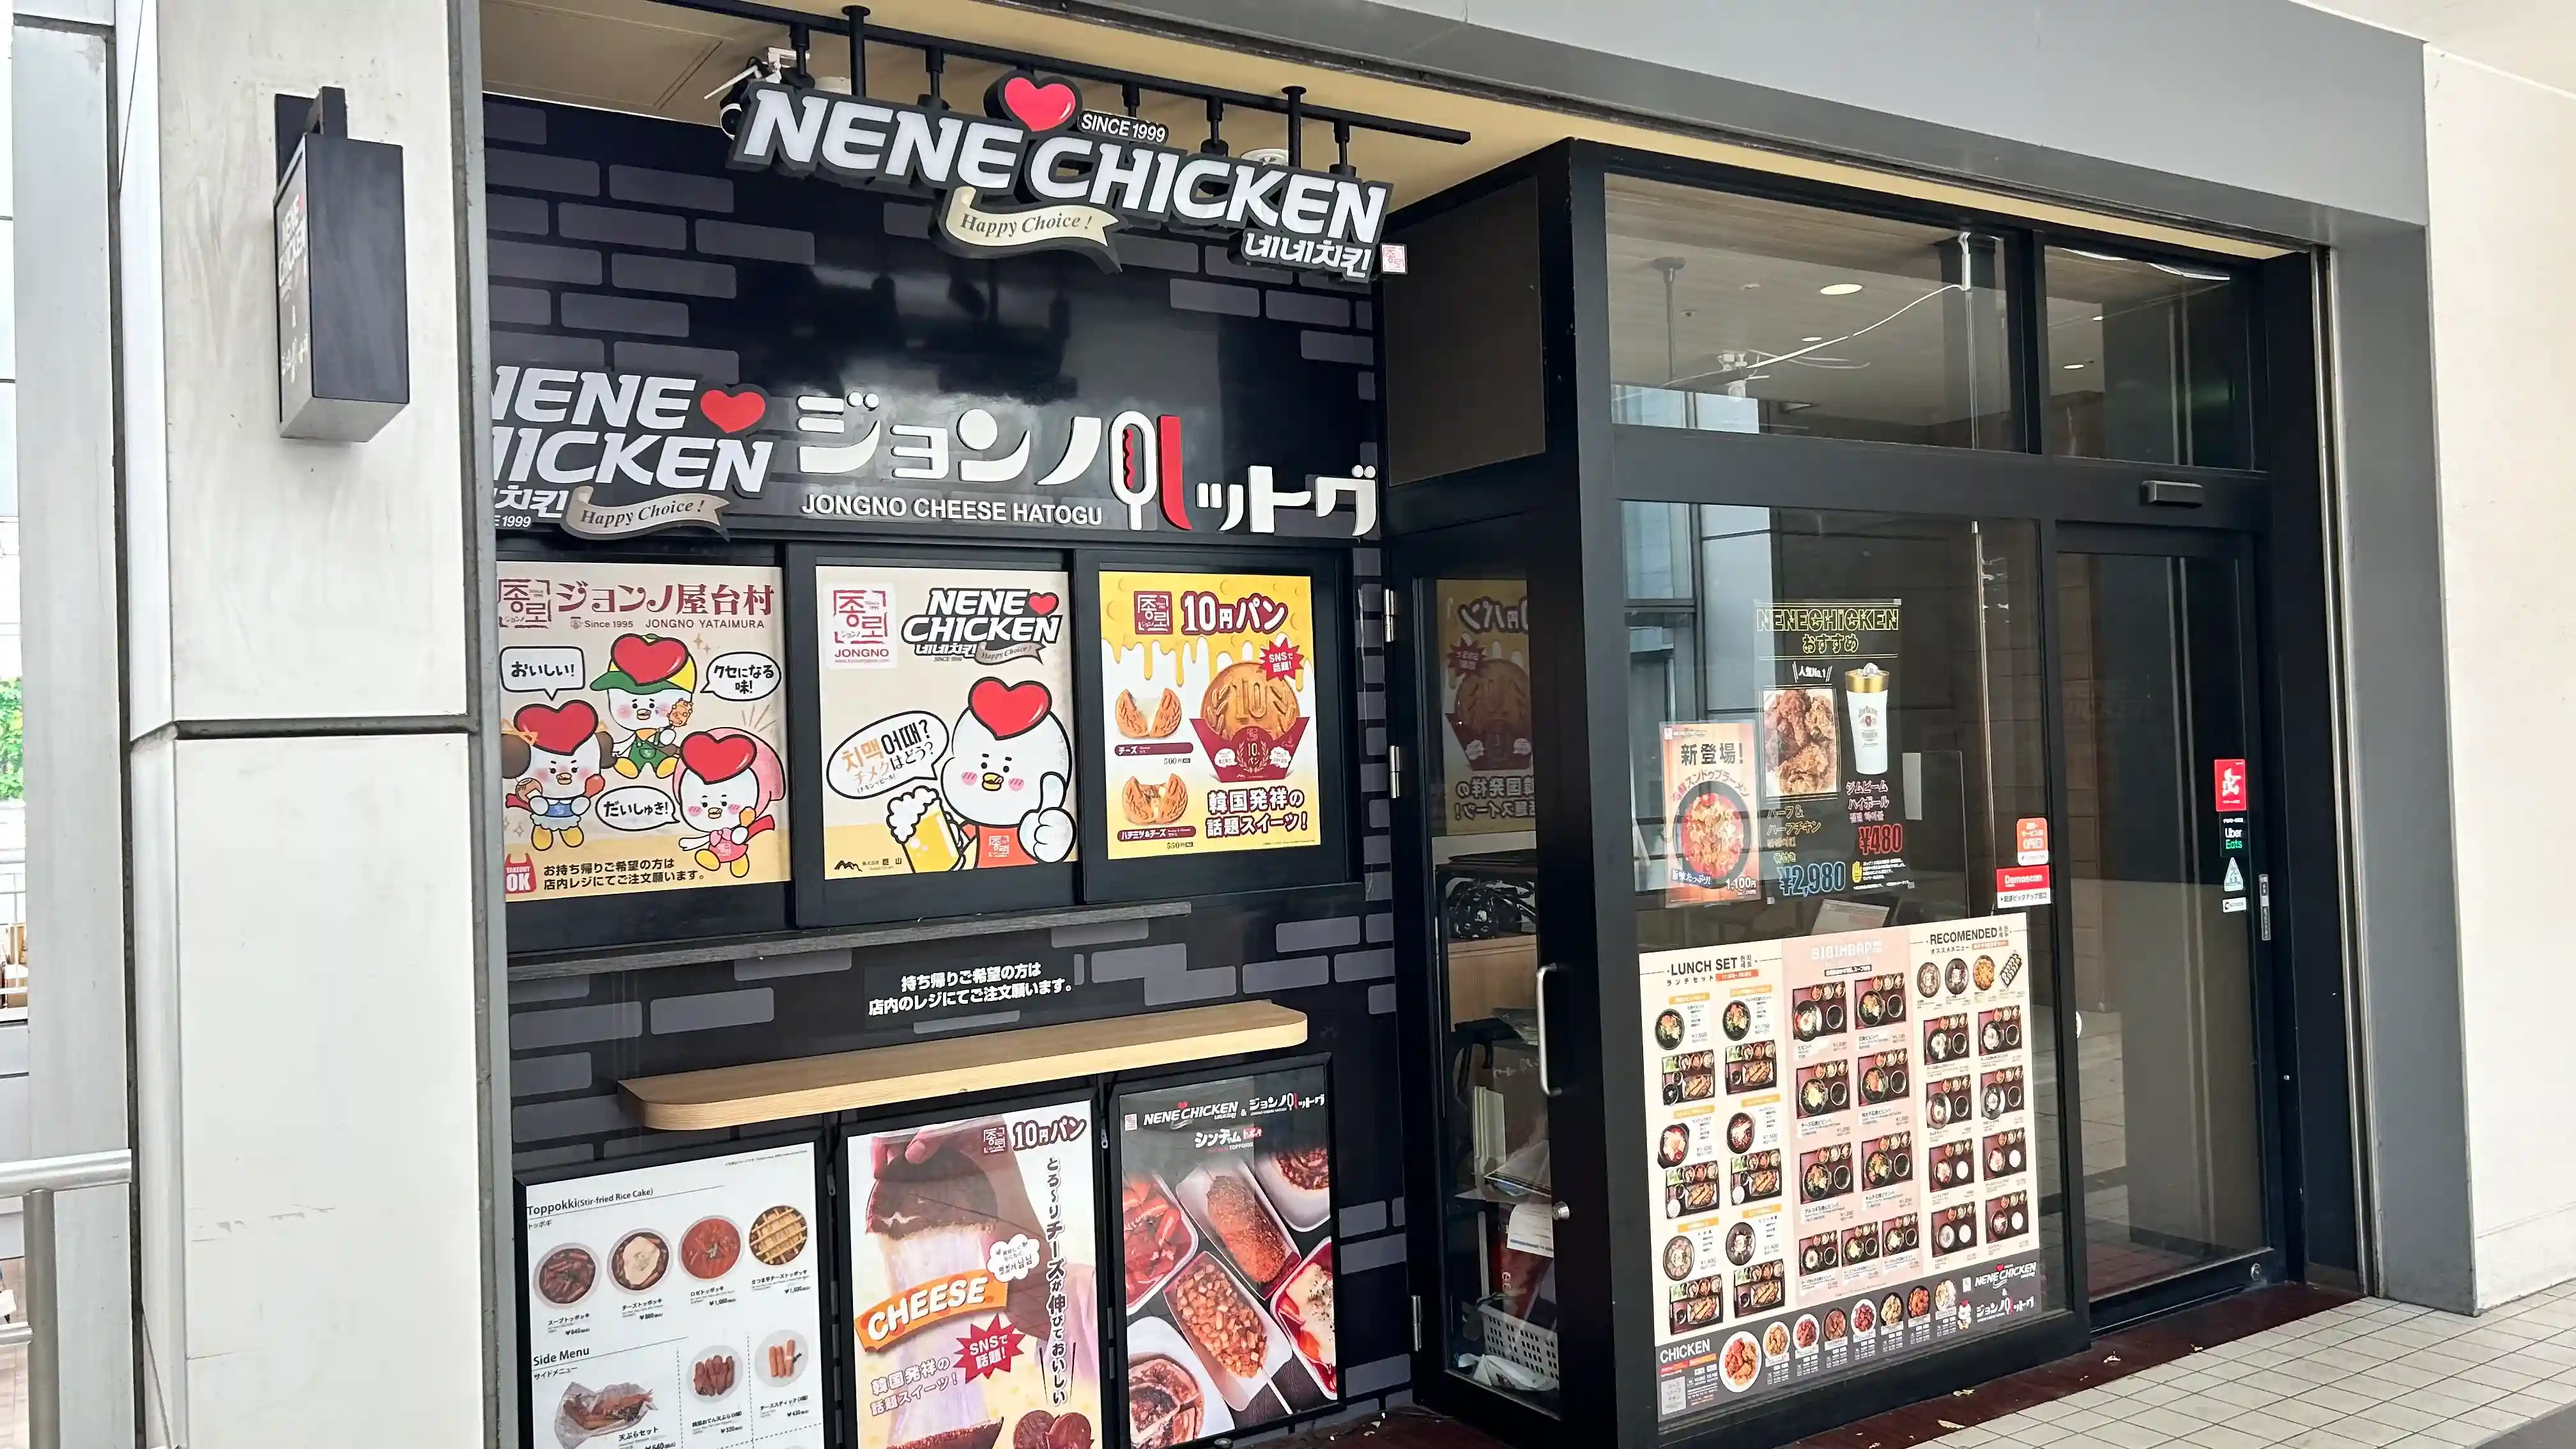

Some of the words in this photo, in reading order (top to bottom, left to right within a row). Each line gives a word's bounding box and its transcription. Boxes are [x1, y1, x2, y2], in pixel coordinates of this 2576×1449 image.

[1080, 113, 1132, 136] SINCE
[1133, 120, 1166, 144] 1999
[745, 89, 1023, 190] NENE
[1027, 135, 1388, 244] CHICKEN
[960, 211, 1018, 238] Happy
[1022, 212, 1081, 234] Choice
[1244, 231, 1372, 279] 네네치킨
[493, 425, 774, 493] ICKEN
[494, 484, 570, 519] 치킨
[801, 493, 908, 518] JONGNO
[913, 498, 1008, 522] CHEESE
[1011, 503, 1103, 526] HATOGU
[502, 516, 532, 528] 1999
[581, 507, 634, 527] Happy
[638, 500, 694, 521] Choice
[556, 579, 774, 617] ジョンノ屋台村
[928, 589, 1028, 615] NENE
[585, 620, 610, 628] Since
[645, 618, 694, 629] JONGNO
[698, 619, 765, 629] YATAIMURA
[1183, 595, 1285, 631] 10円パン
[903, 615, 1061, 643] CHICKEN
[834, 648, 889, 657] JONGNO
[1802, 633, 1859, 654] おすすめ
[981, 651, 1002, 661] Happy
[1268, 652, 1293, 663] SNSで
[510, 661, 575, 678] おいしい!
[713, 664, 775, 679] クセになる
[735, 680, 753, 695] 味!
[1118, 746, 1138, 755] チーズ
[1680, 742, 1744, 766] 新登場!
[602, 800, 669, 817] だいしゅき!
[1208, 788, 1304, 814] 韓国発祥の
[1848, 795, 1890, 811] ハイボール
[1206, 813, 1308, 838] 話題スイーツ!
[2225, 827, 2242, 838] Uber
[1858, 823, 1903, 855] ¥480
[2225, 839, 2242, 850] Eats
[543, 857, 675, 877] お持ち帰りご希望の方は
[506, 873, 531, 892] OK
[543, 870, 705, 891] 店内レジにてご注文願います。
[1777, 861, 1846, 898] ¥2,980
[1930, 927, 1997, 945] RECOMENDED
[901, 962, 1041, 993] 持ち帰りご希望の方は
[1671, 960, 1712, 976] LUNCH
[1715, 957, 1738, 970] SET
[1667, 974, 1713, 986] ランチセット
[1143, 1110, 1181, 1126] NENE
[1181, 1101, 1239, 1119] CHICKEN
[1015, 1117, 1085, 1150] 10円パン
[615, 1192, 631, 1201] Rice
[632, 1187, 654, 1198] Cake)
[1999, 1261, 2037, 1280] CHICKEN
[868, 1276, 989, 1341] CHEESE
[533, 1353, 556, 1367] Side
[560, 1346, 590, 1363] Menu
[969, 1334, 1009, 1357] SNSで
[1659, 1338, 1711, 1364] CHICKEN
[975, 1348, 1007, 1370] 話題!
[533, 1366, 578, 1381] サイドメニュー
[871, 1356, 951, 1397] 韓国発祥の
[870, 1372, 959, 1417] 話題スイーツ!
